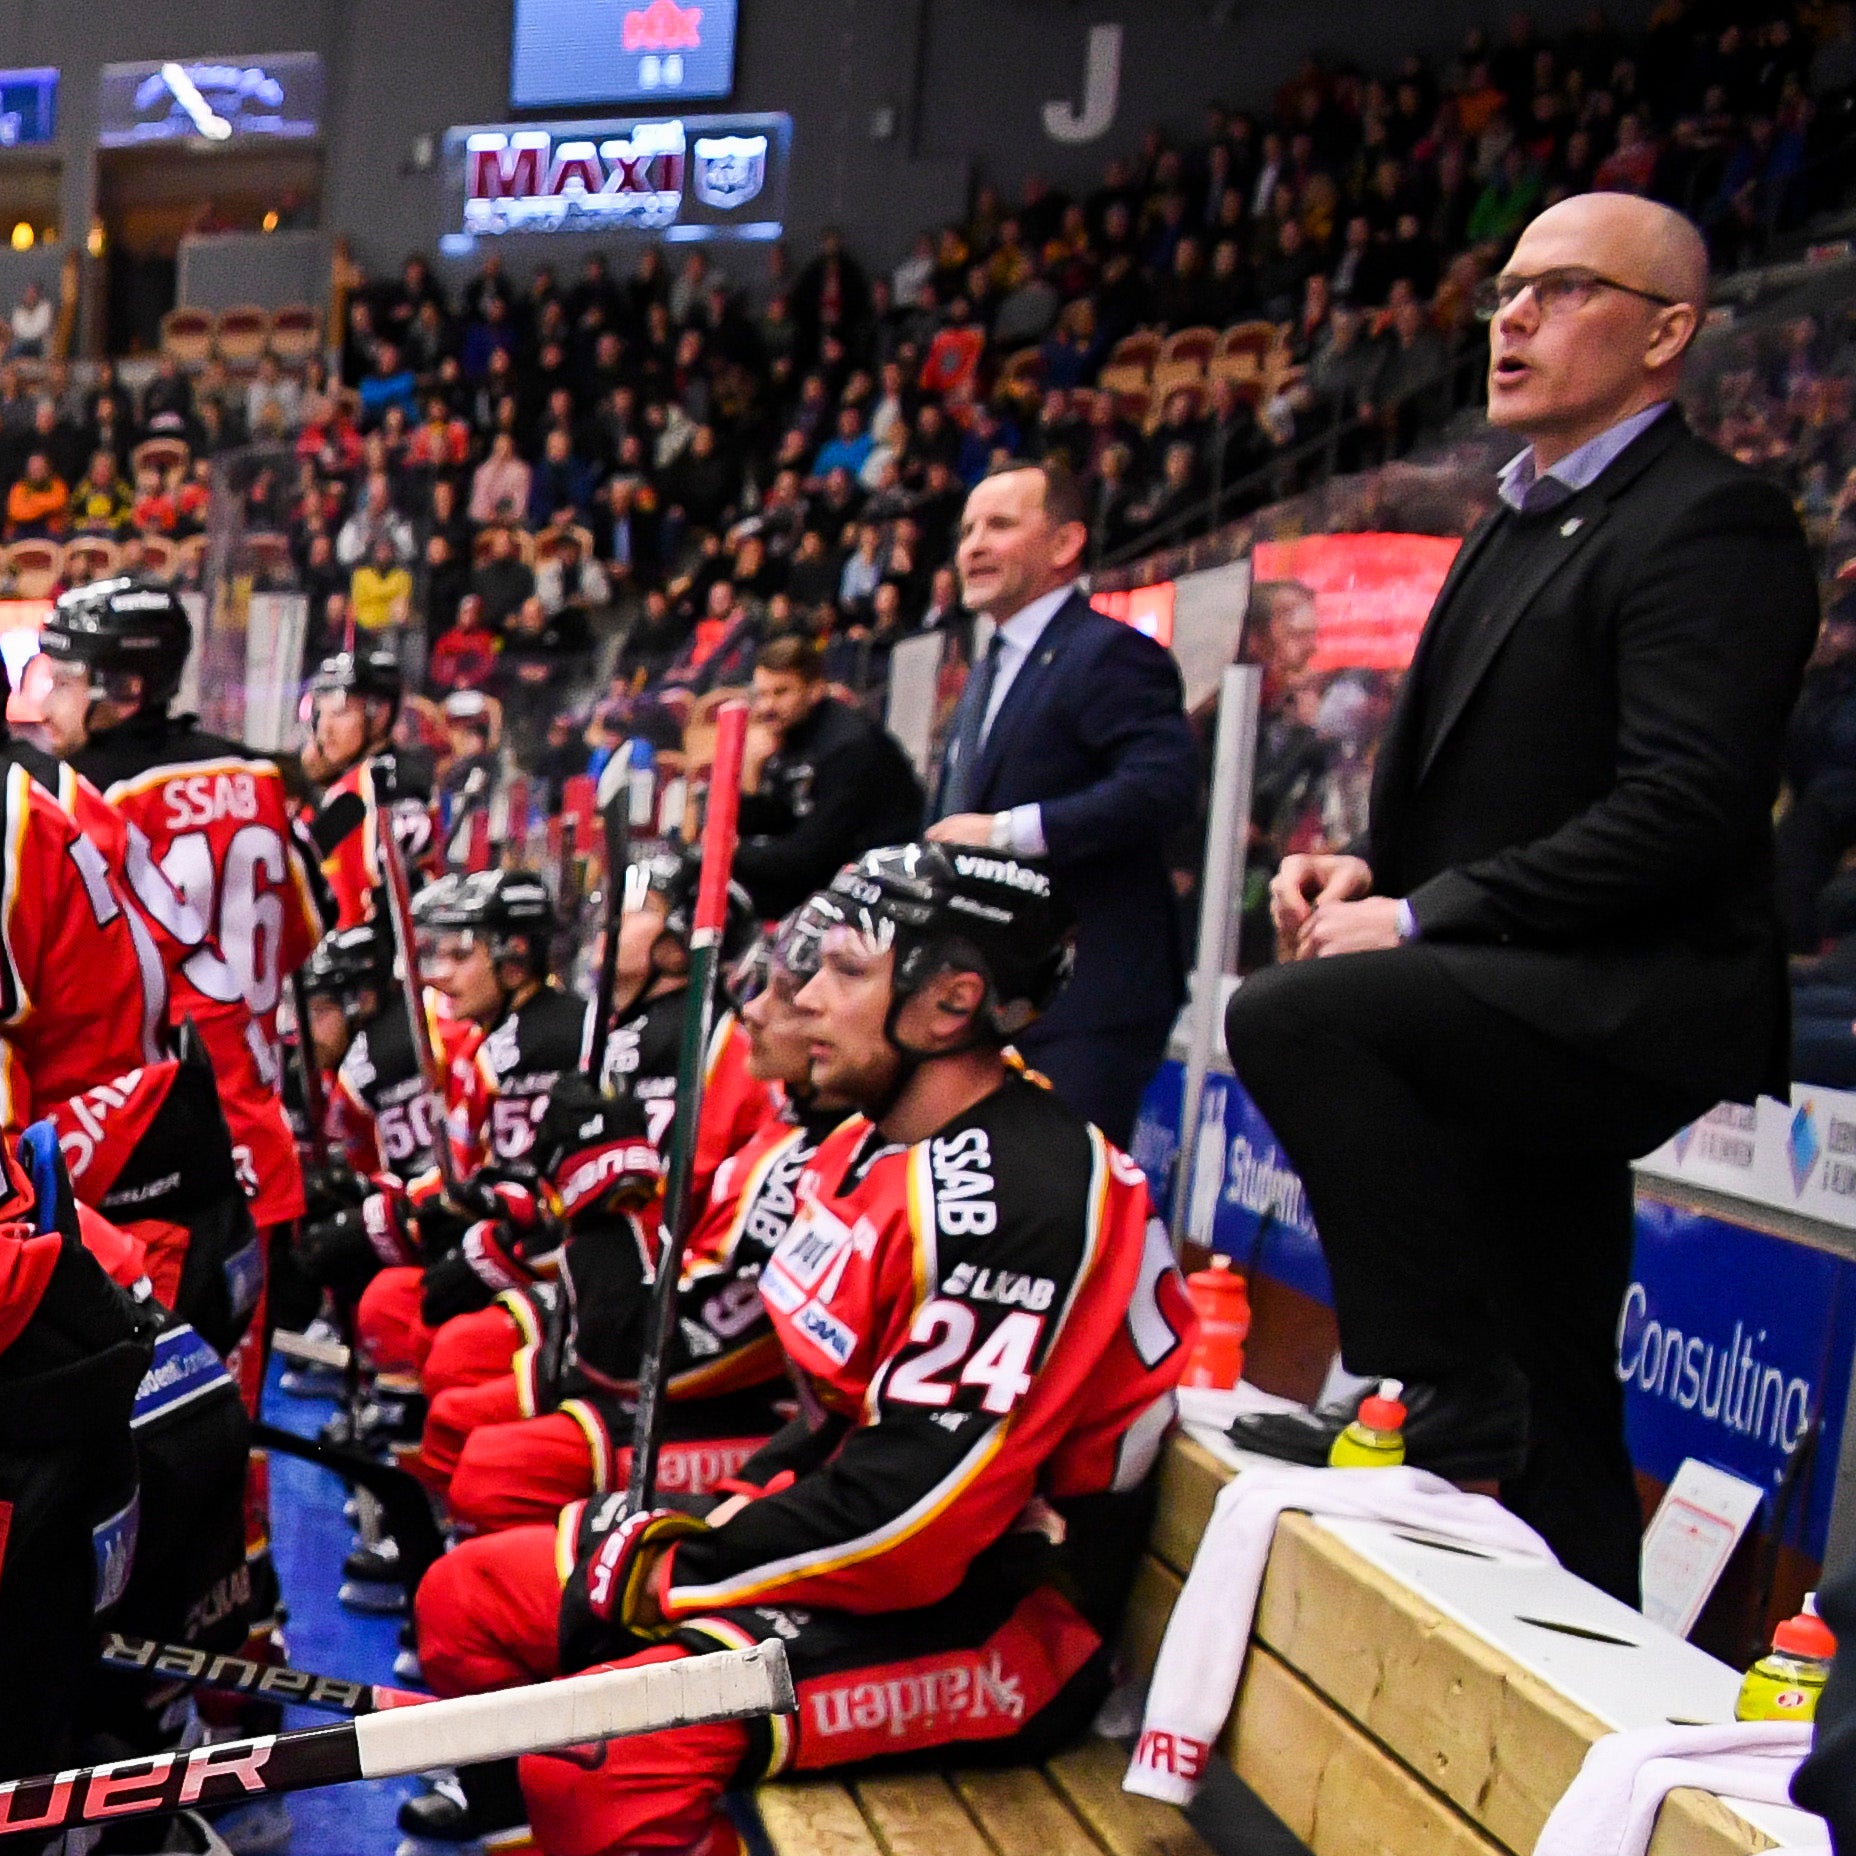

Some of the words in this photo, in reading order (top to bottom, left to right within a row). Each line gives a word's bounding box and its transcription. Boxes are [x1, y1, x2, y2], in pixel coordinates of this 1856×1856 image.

[1042, 24, 1122, 142] J
[162, 773, 258, 831] SSAB
[930, 1127, 998, 1237] SSAB
[886, 1298, 1048, 1415] 24
[101, 1631, 365, 1710] BAUER
